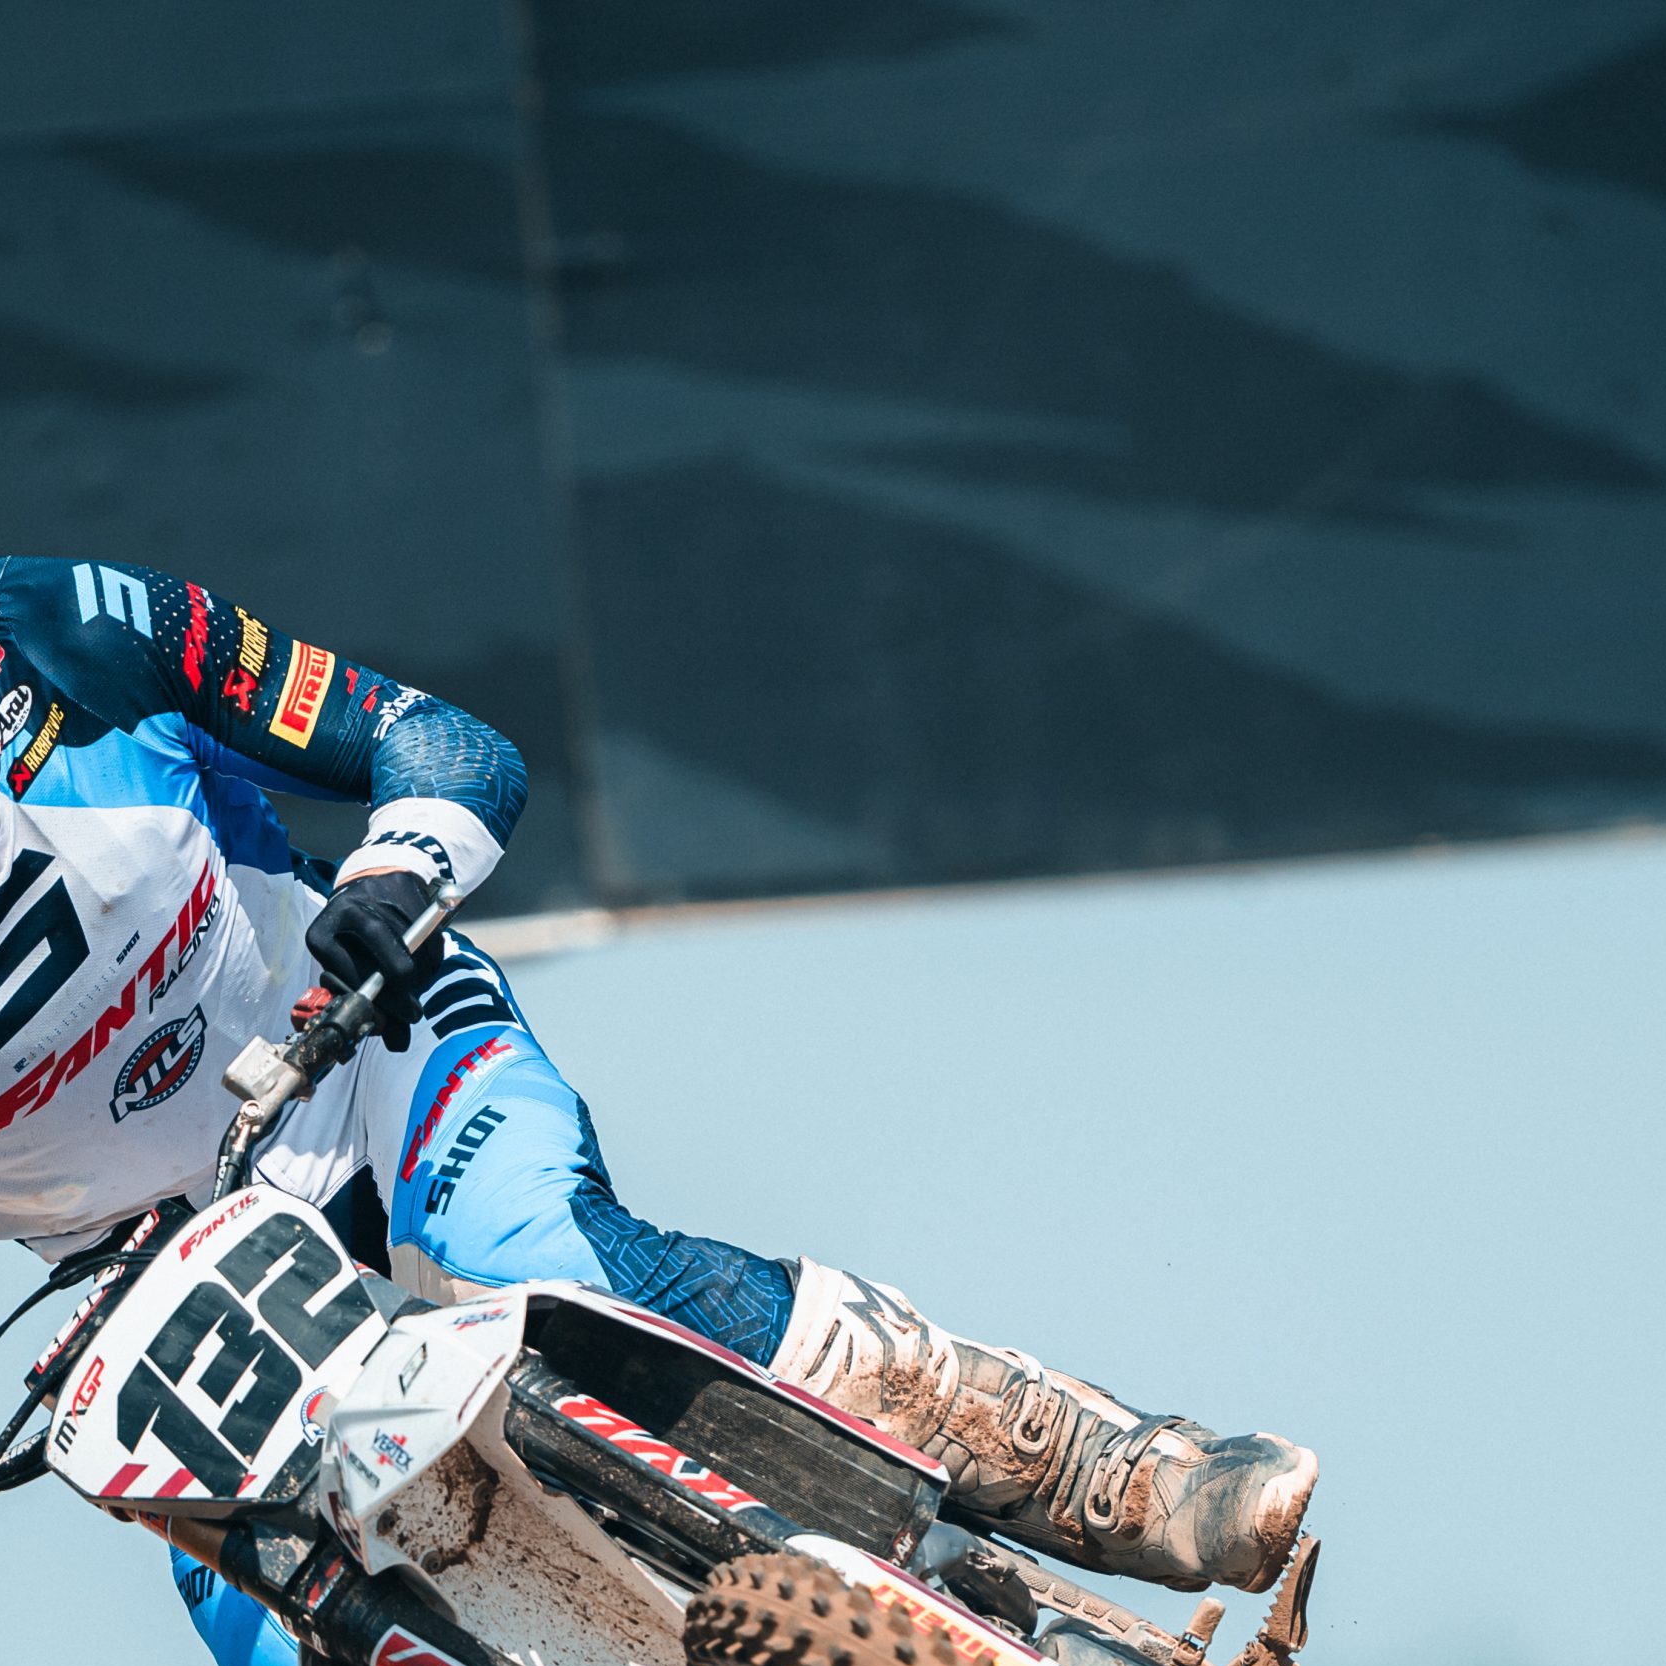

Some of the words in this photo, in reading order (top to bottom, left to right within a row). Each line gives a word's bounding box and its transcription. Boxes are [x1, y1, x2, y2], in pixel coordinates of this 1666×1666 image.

[116, 930, 141, 965] SHOT
[148, 896, 220, 1014] RACING
[110, 1003, 208, 1123] NILS
[400, 1037, 512, 1183] FANTIC
[425, 1104, 507, 1215] SHOT
[179, 1192, 259, 1262] FANTIC
[117, 1212, 376, 1498] 132
